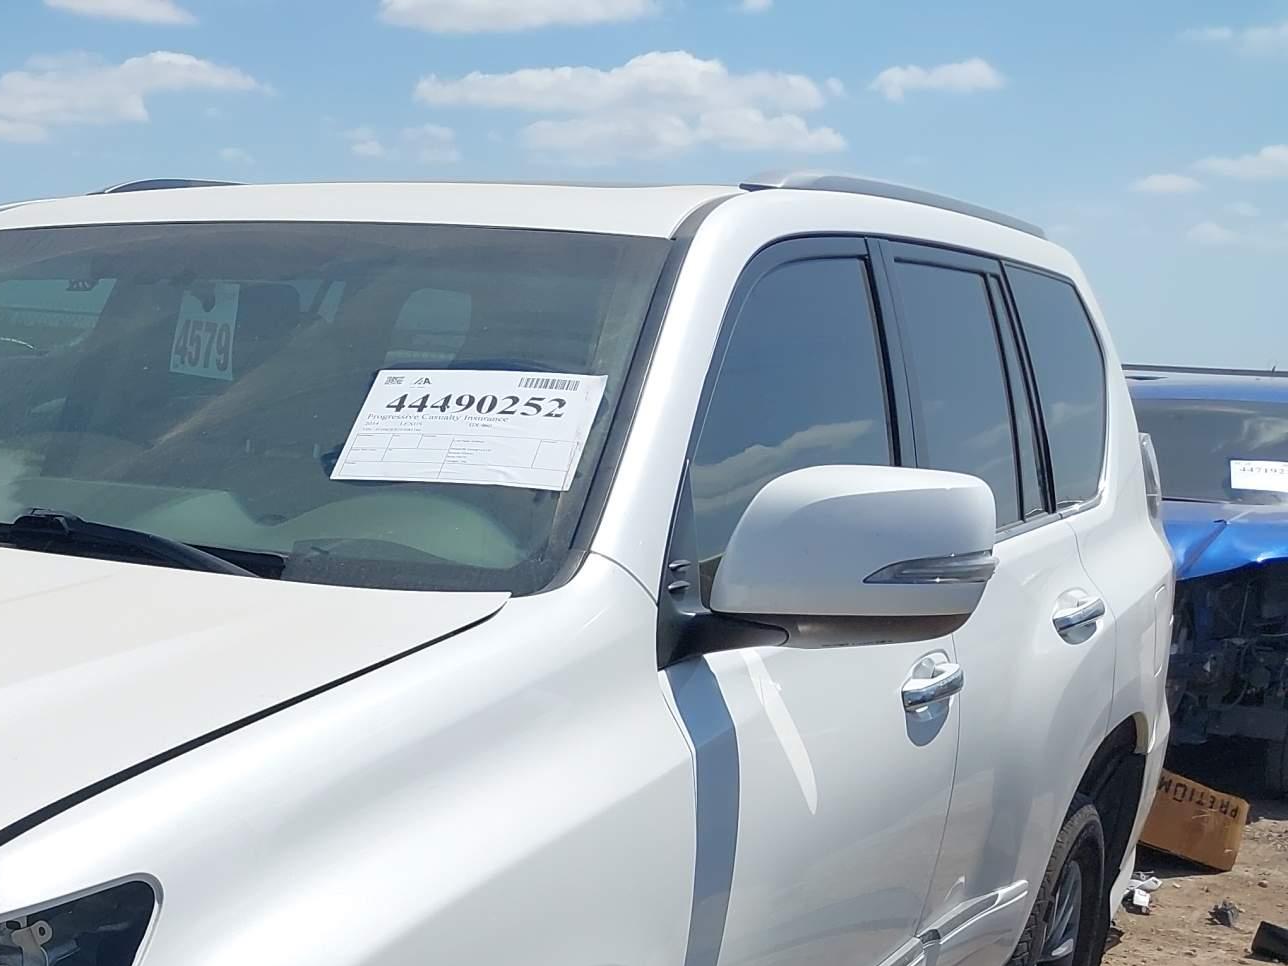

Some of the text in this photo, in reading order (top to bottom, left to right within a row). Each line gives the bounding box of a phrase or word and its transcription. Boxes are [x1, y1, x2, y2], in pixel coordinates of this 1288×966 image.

[173, 319, 231, 372] 4579
[367, 413, 510, 422] Progressive Casualty Insurance
[385, 393, 567, 418] 44490252
